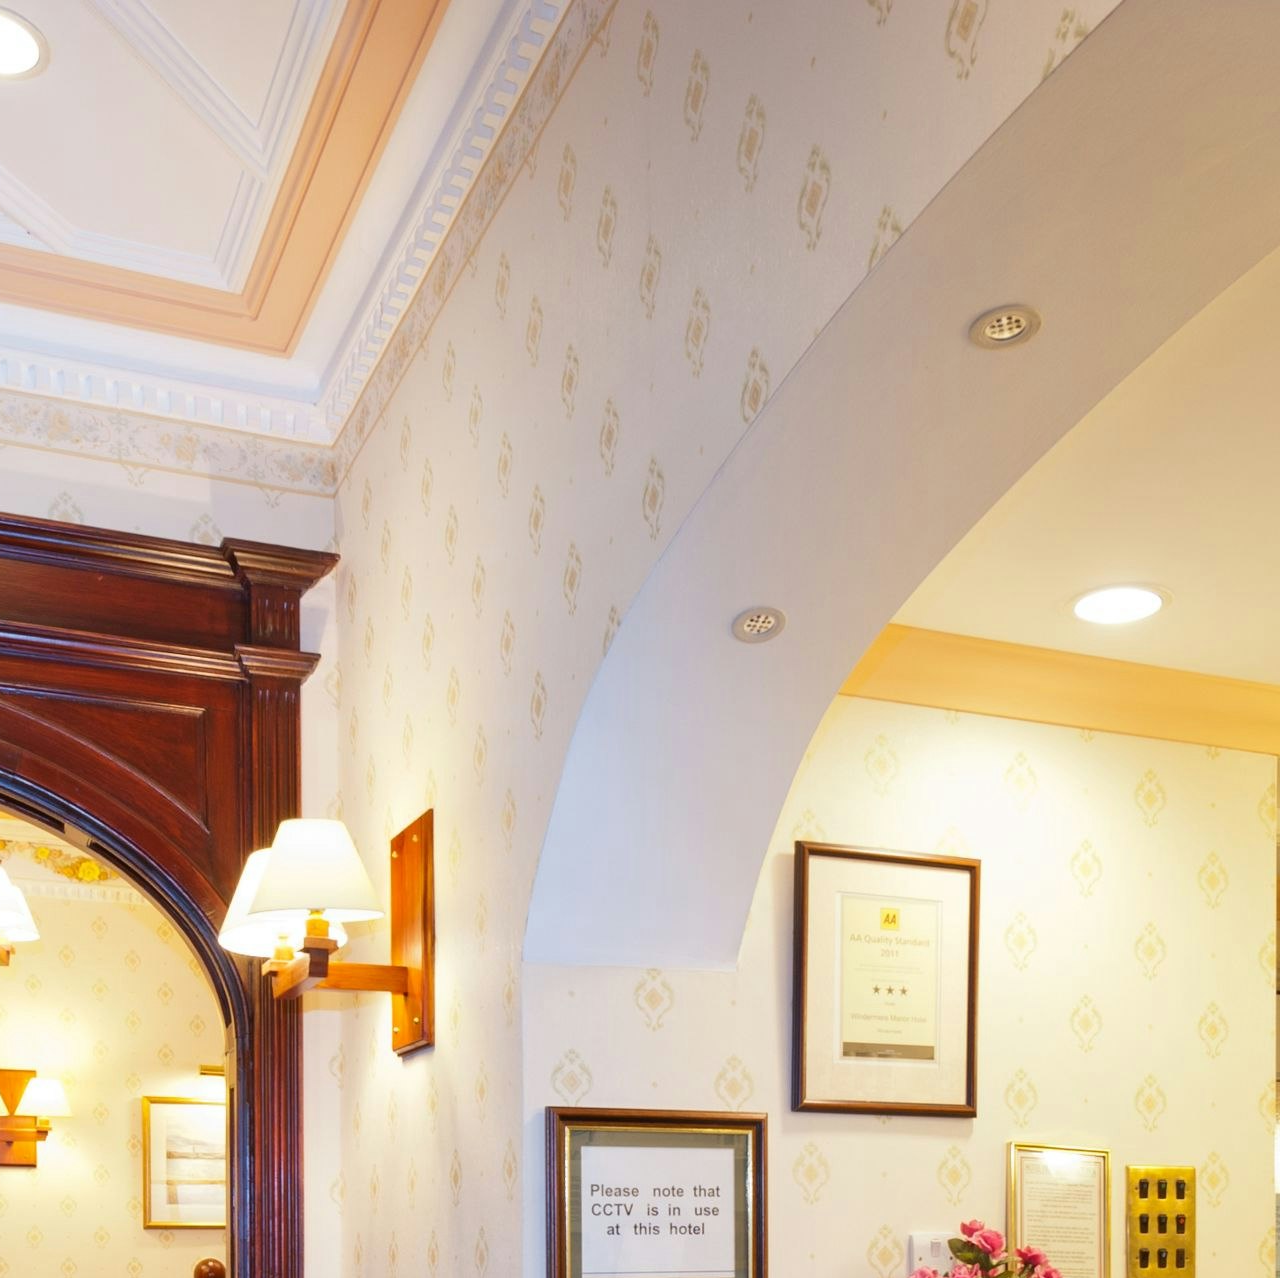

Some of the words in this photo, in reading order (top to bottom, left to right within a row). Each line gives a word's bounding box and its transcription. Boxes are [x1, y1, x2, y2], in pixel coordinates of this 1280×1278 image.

[883, 912, 897, 925] AA
[849, 933, 863, 944] AA
[864, 934, 893, 947] Quality
[590, 1183, 640, 1198] Please
[652, 1184, 685, 1198] note
[693, 1184, 721, 1198] that
[591, 1203, 634, 1216] CCTV
[646, 1203, 659, 1216] is
[668, 1203, 681, 1216] in
[694, 1206, 720, 1216] use
[606, 1224, 621, 1236] at
[633, 1223, 660, 1235] this
[669, 1222, 706, 1236] hotel
